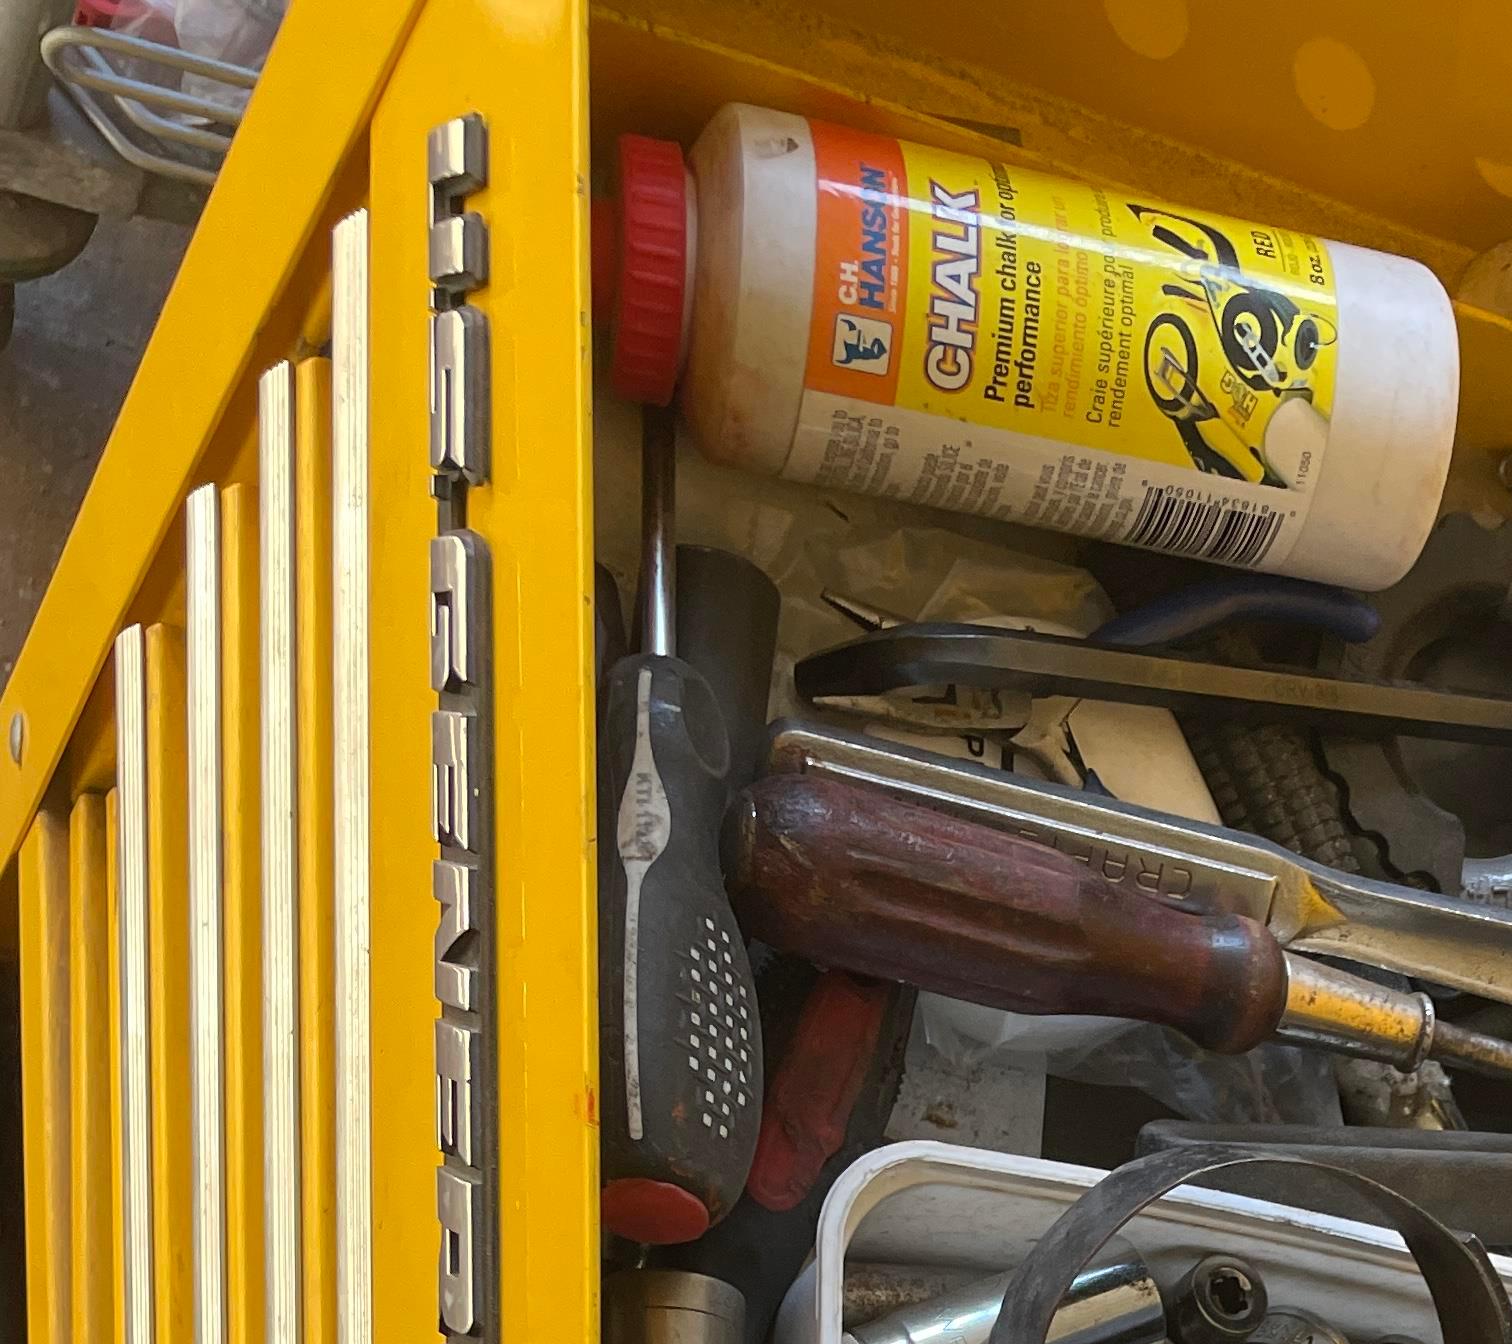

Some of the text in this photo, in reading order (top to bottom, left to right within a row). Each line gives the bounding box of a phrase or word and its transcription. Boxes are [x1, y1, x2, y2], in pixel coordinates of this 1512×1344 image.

[859, 162, 887, 309] HANSON
[995, 231, 1017, 293] chalk
[1250, 230, 1276, 259] RED
[838, 259, 858, 305] C.H.
[924, 177, 982, 393] CHALK
[1057, 256, 1074, 299] para
[1309, 272, 1325, 286] 8
[984, 298, 1016, 403] Premium
[1014, 261, 1042, 409] performance
[1050, 306, 1069, 378] superior
[1096, 276, 1116, 375] supérieure
[1108, 263, 1138, 429] rendement optimal
[1040, 384, 1058, 414] Tiza
[1063, 313, 1087, 419] rendimiento
[1086, 379, 1109, 426] Craie
